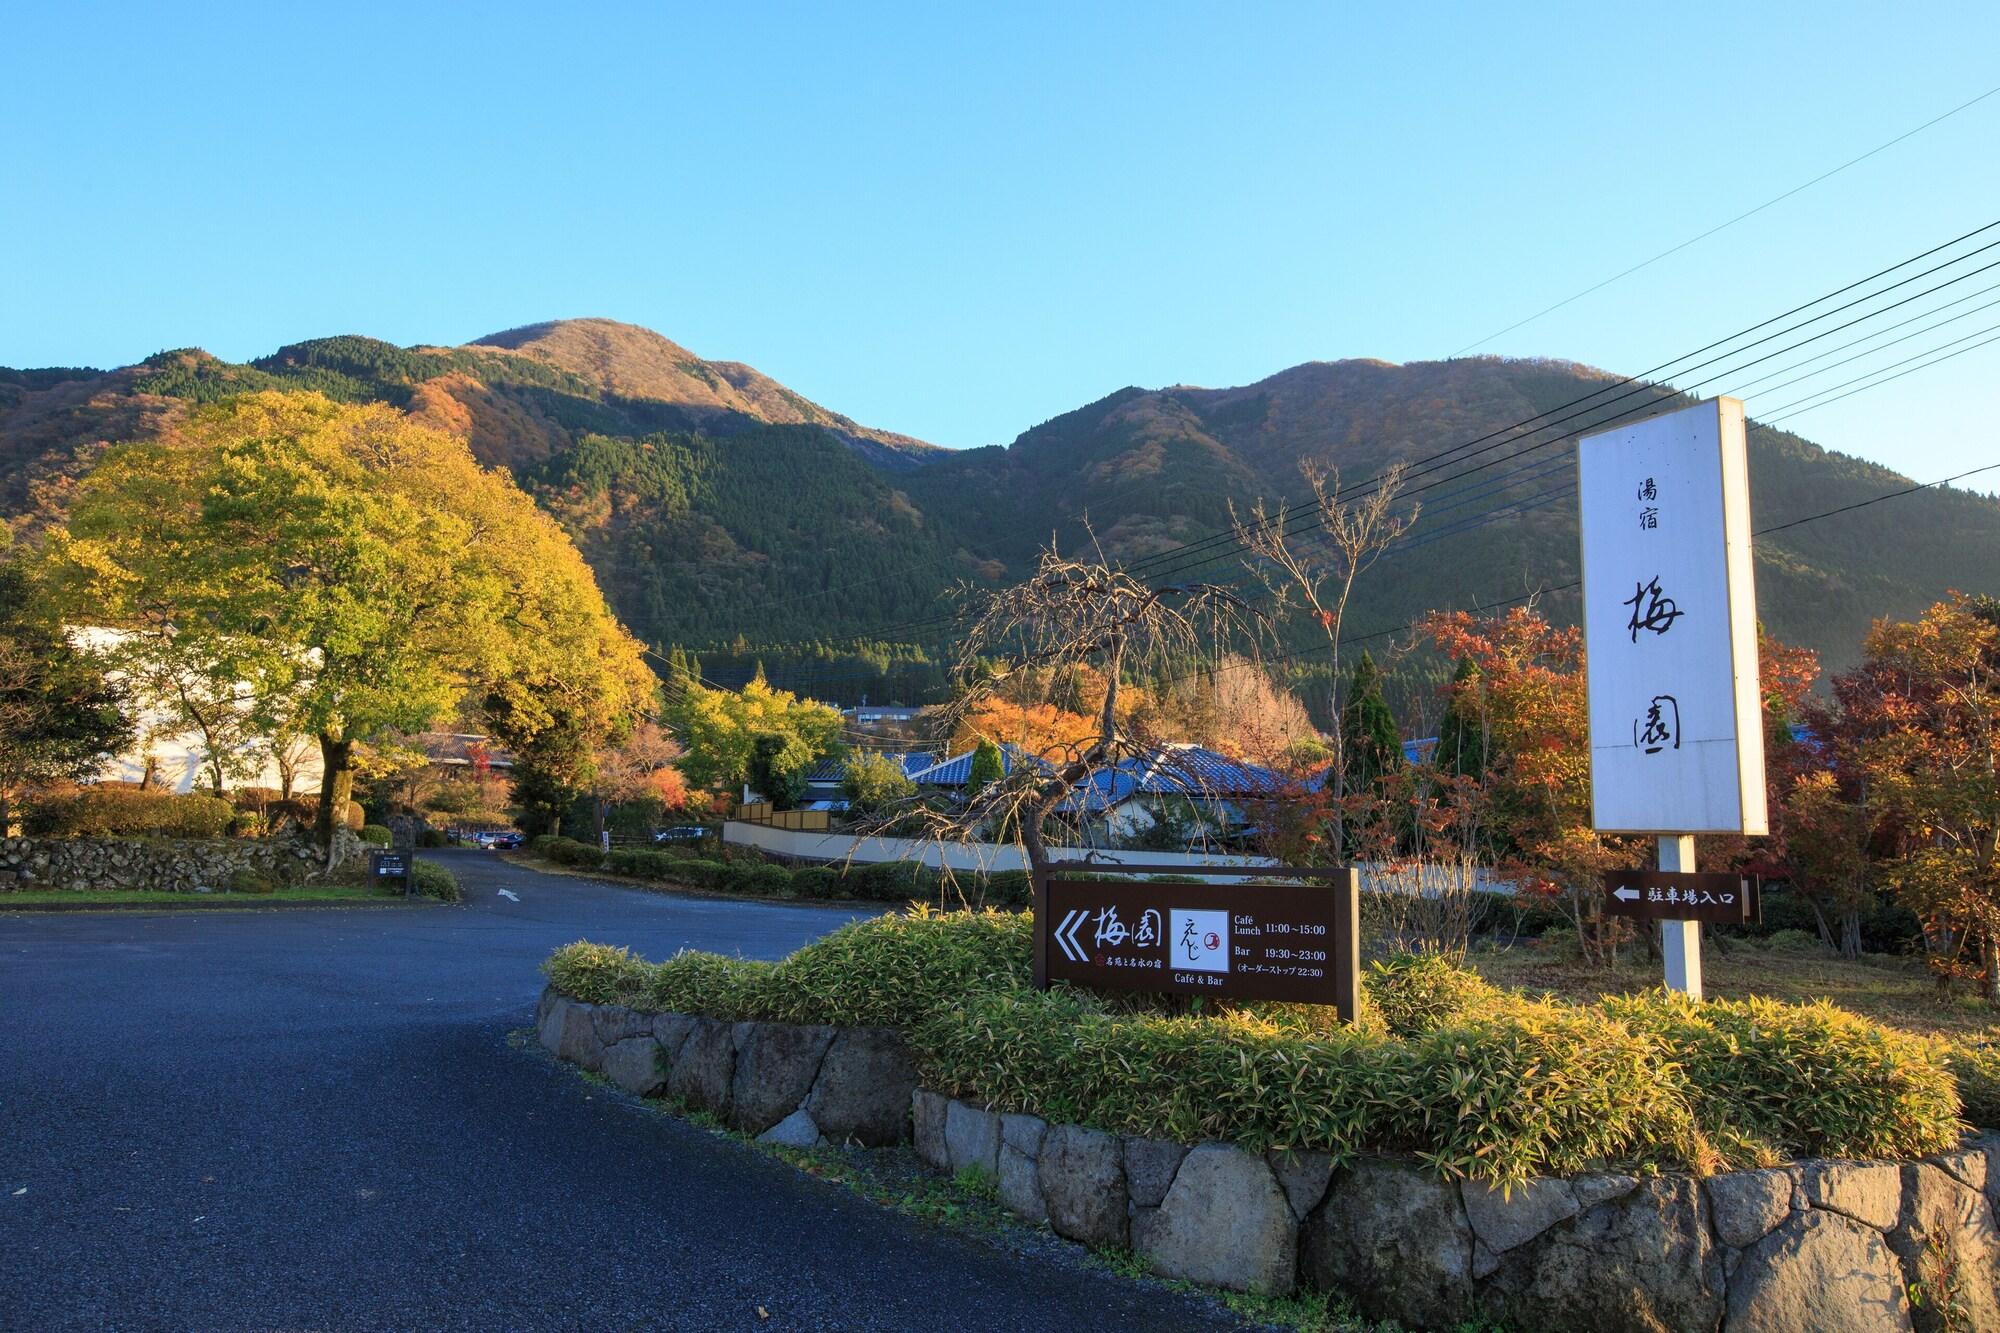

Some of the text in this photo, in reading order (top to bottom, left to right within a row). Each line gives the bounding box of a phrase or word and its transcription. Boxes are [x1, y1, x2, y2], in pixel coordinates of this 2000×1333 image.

[1637, 476, 1658, 531] 湯宿
[1623, 574, 1685, 755] 梅園
[1647, 886, 1735, 905] 駐車場入口
[1091, 904, 1162, 949] 梅園
[1234, 914, 1254, 925] Café
[1179, 918, 1201, 961] えんじ
[1234, 925, 1261, 936] Lunch
[1234, 945, 1251, 956] Bar
[1174, 973, 1224, 986] Café & Bar
